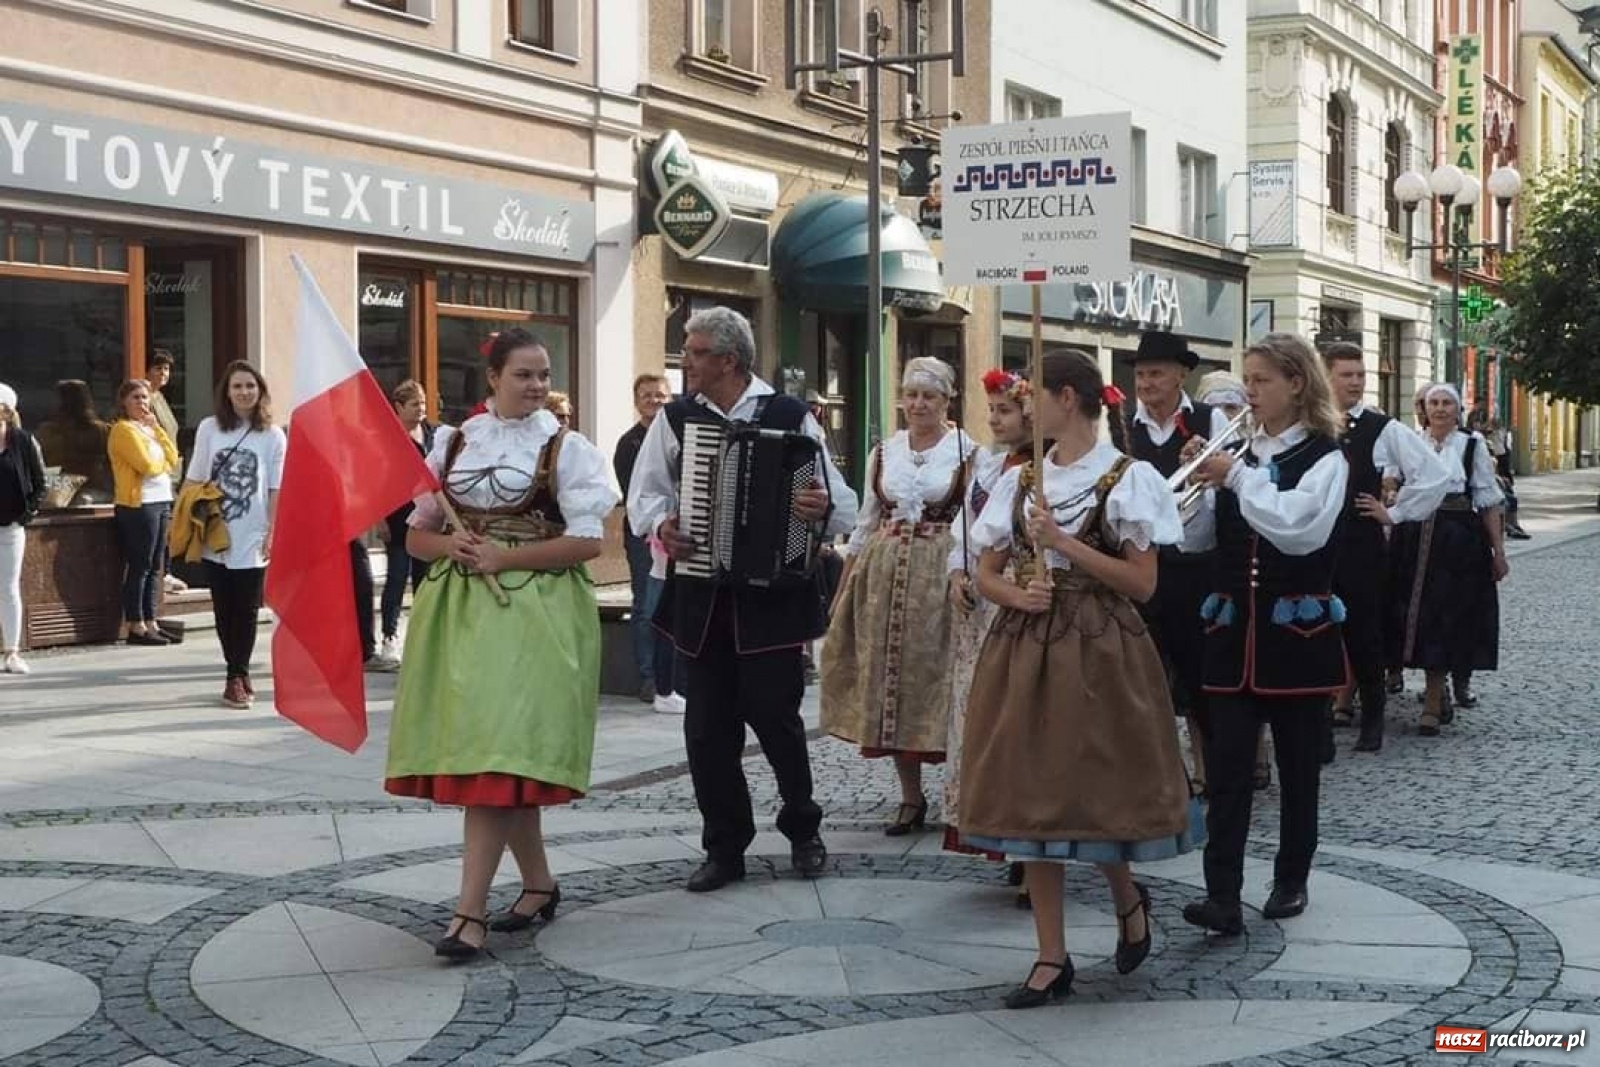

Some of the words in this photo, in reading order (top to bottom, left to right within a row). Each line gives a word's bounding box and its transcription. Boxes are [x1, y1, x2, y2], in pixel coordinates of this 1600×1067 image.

[1060, 130, 1109, 151] TAŃCA
[258, 157, 465, 236] TEXTIL
[970, 193, 1096, 222] STRZECHA
[493, 196, 570, 247] Škodák
[663, 211, 712, 223] BERNARD
[1052, 264, 1089, 276] POLAND
